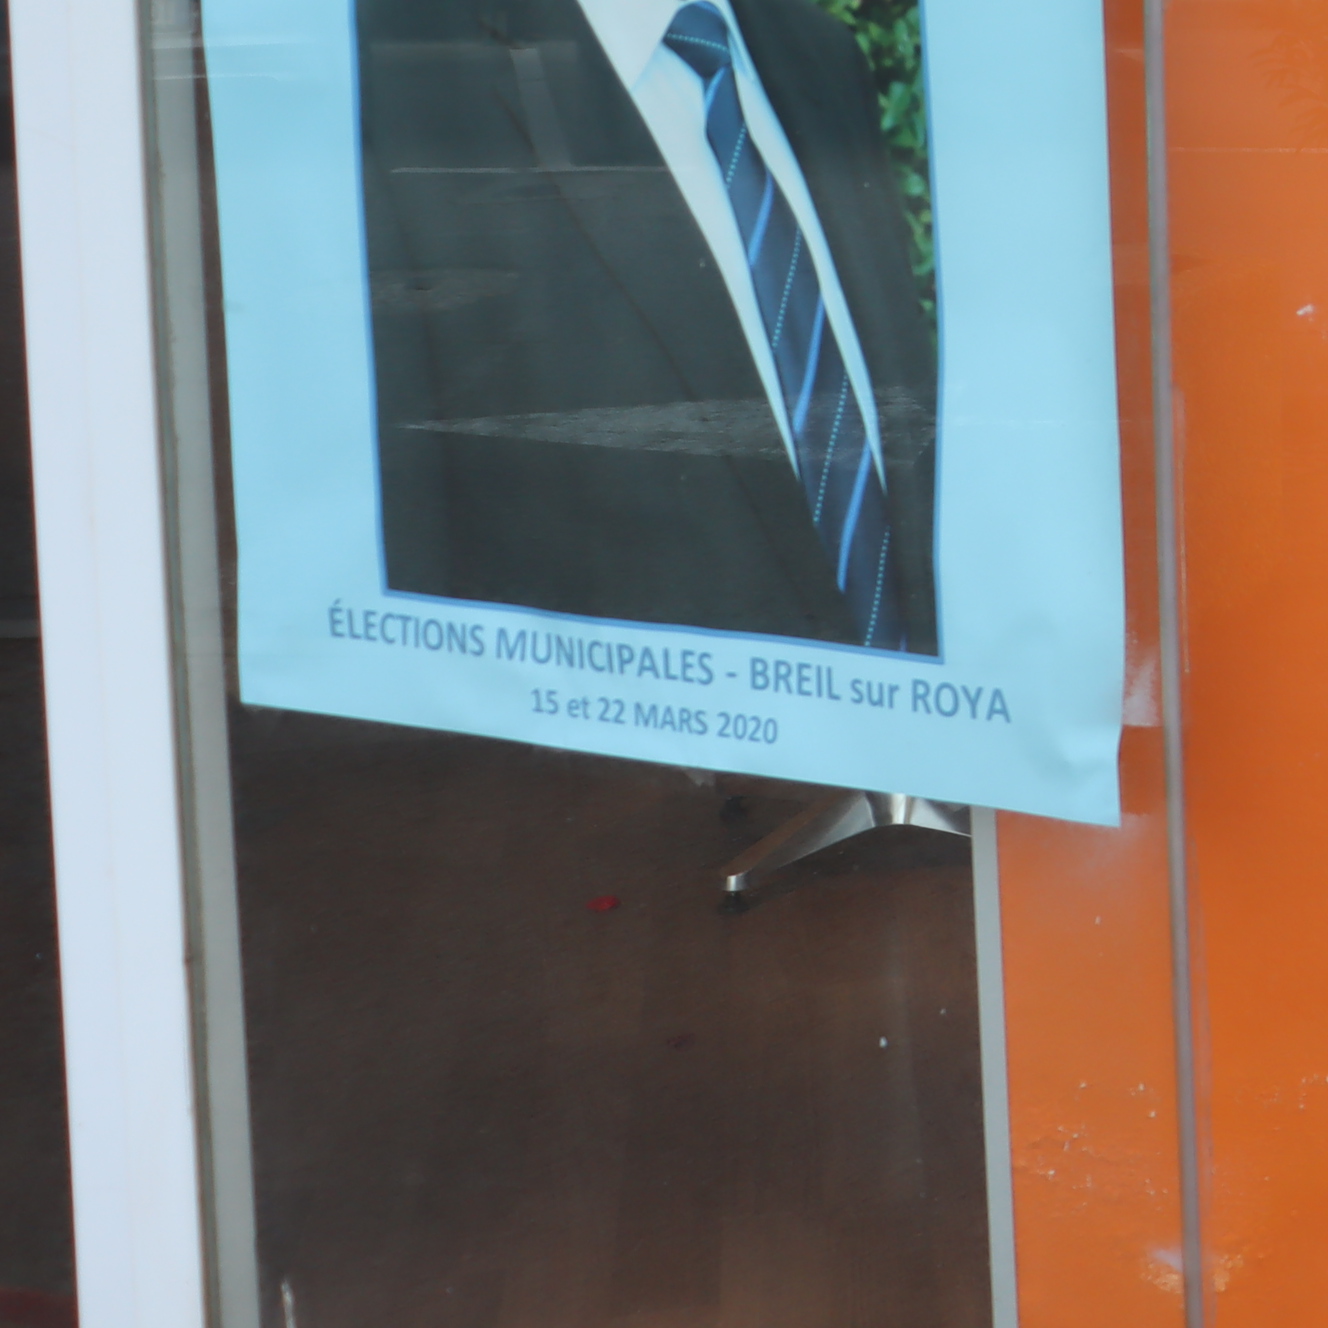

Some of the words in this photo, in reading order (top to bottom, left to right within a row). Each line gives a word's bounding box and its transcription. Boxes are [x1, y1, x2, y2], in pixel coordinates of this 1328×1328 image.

[329, 599, 485, 657] ÉLECTIONS
[496, 628, 714, 686] MUNICIPALES
[751, 657, 840, 701] BREIL
[850, 678, 899, 709] sur
[911, 678, 1011, 724] ROYA
[531, 688, 558, 716] 15
[567, 696, 591, 720] et
[598, 697, 626, 724] 22
[634, 702, 707, 736] MARS
[717, 712, 778, 745] 2020
